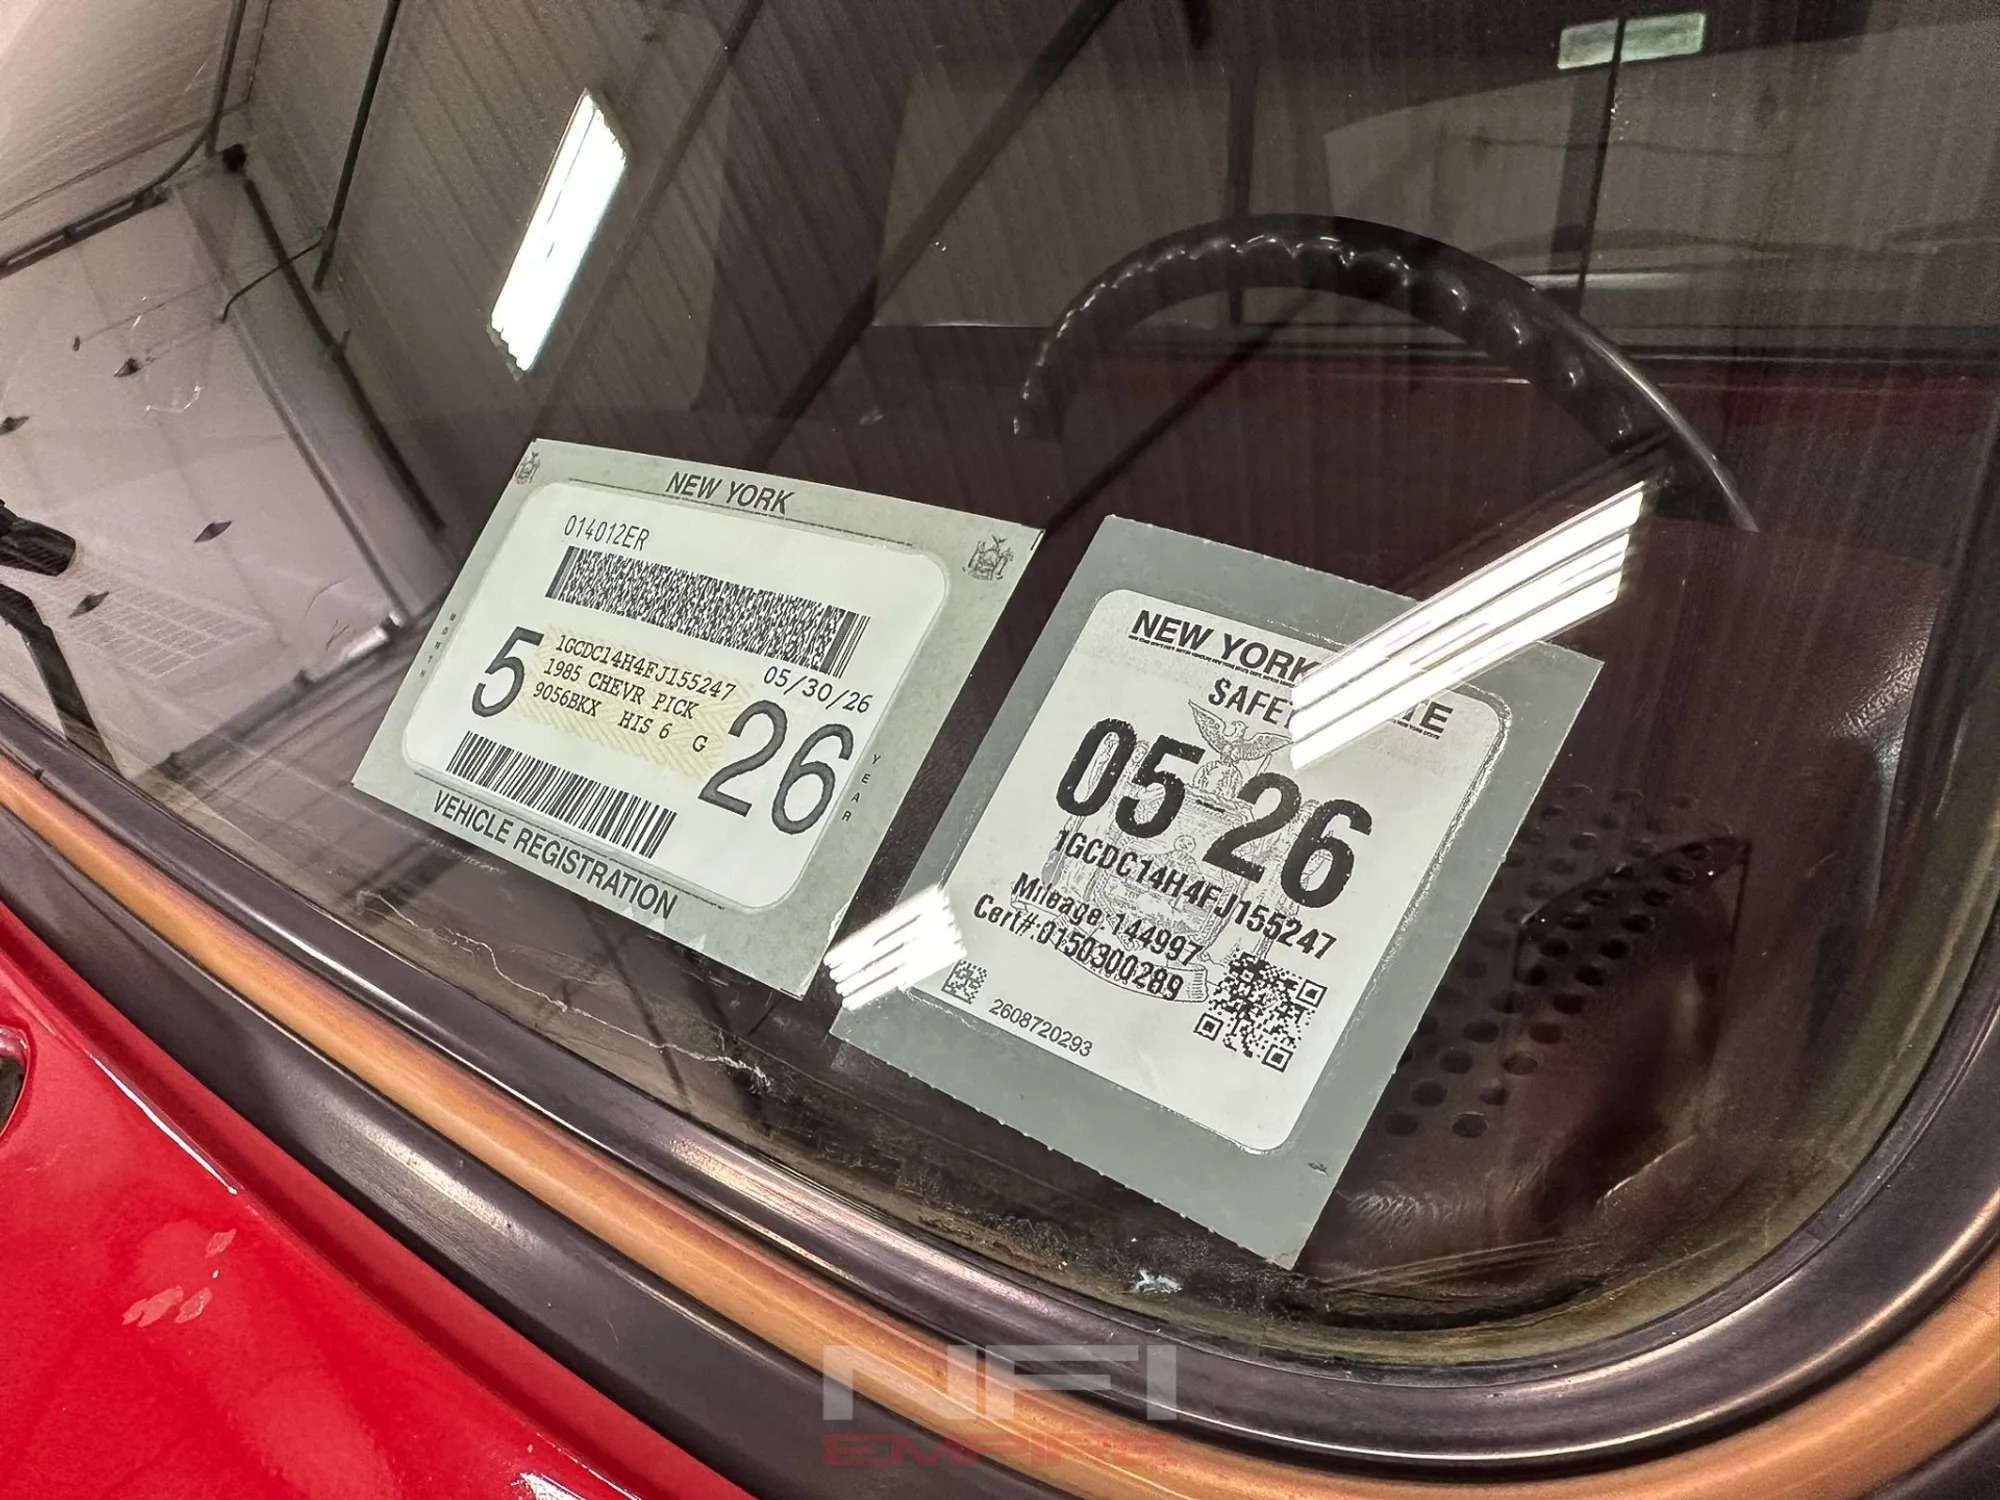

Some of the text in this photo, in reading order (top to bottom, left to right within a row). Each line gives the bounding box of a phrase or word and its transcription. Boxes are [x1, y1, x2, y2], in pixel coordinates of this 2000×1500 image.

[665, 471, 795, 515] NEW YORK
[563, 514, 650, 551] 014012ER
[471, 625, 545, 718] 5
[556, 634, 736, 701] 1GCDC14H4FJ155247
[1131, 609, 1215, 651] NEW
[1220, 633, 1322, 682] YORK
[533, 681, 709, 753] 9056BKX HIS 6 G
[543, 657, 700, 720] 1985 CHEVR PICK
[763, 665, 873, 714] 05/30/26
[1208, 676, 1298, 730] SAFE
[698, 699, 854, 836] 26
[842, 753, 882, 823] YEAR
[432, 790, 679, 920] VEHICLE REGISTRATION
[1053, 828, 1338, 960] 1GCDC14H4FJ155247
[988, 998, 1093, 1057] 2608720293
